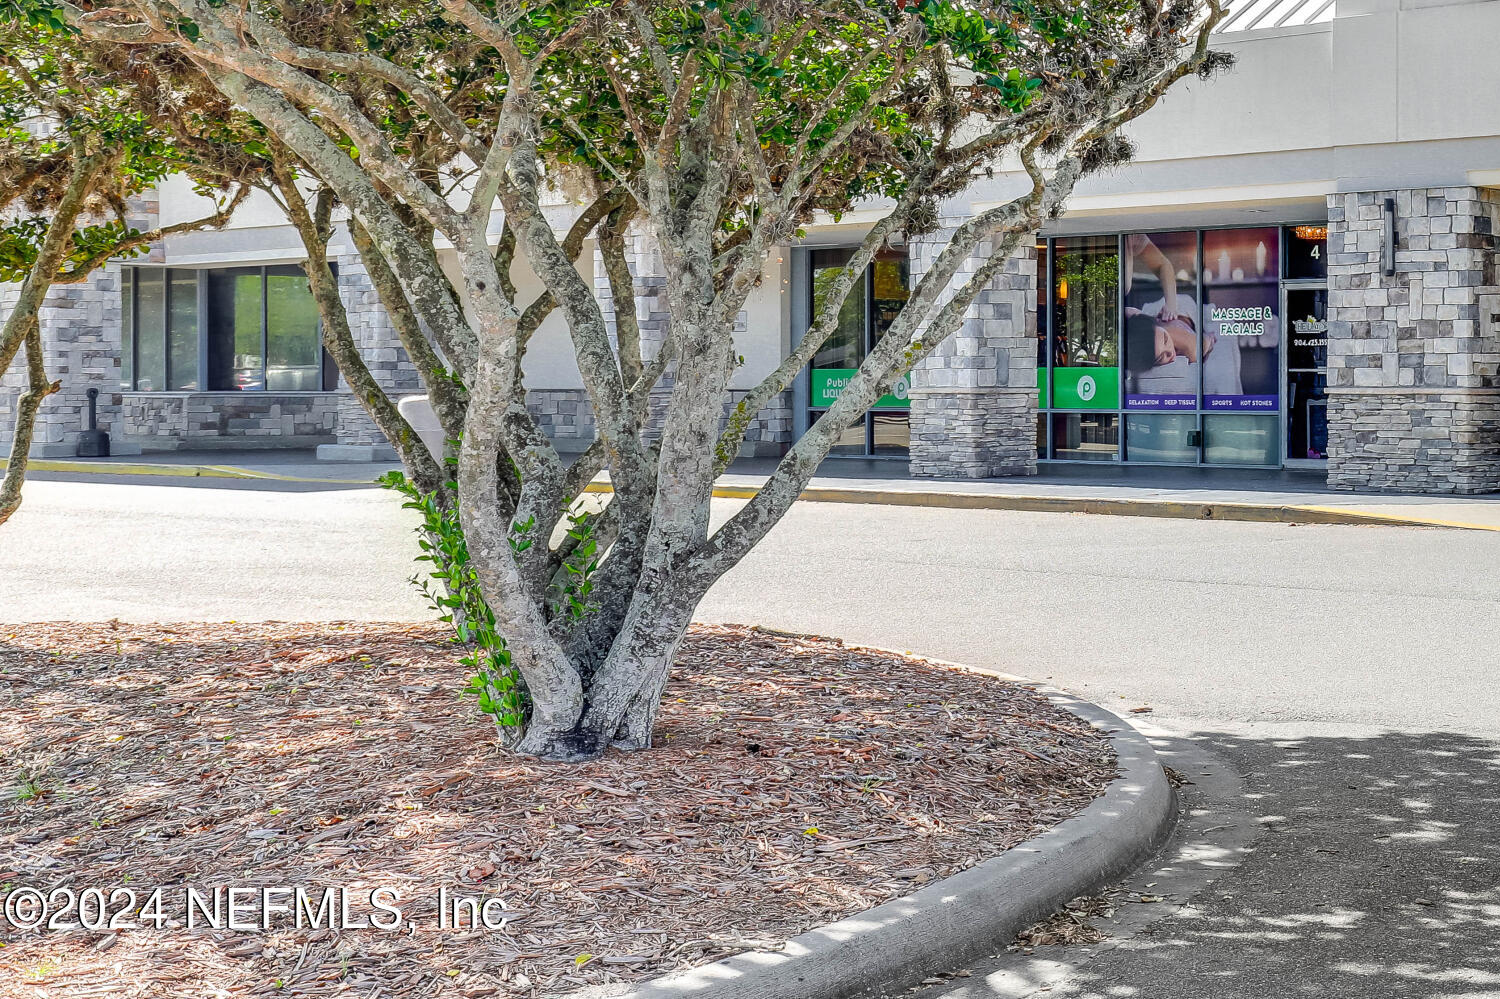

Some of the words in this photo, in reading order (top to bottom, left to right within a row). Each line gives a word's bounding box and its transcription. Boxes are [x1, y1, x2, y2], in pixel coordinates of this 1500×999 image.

[1310, 244, 1321, 260] 4
[1211, 307, 1262, 320] MASSAGE
[1263, 306, 1273, 320] &
[1220, 322, 1264, 335] FACIALS
[826, 378, 848, 387] Publi
